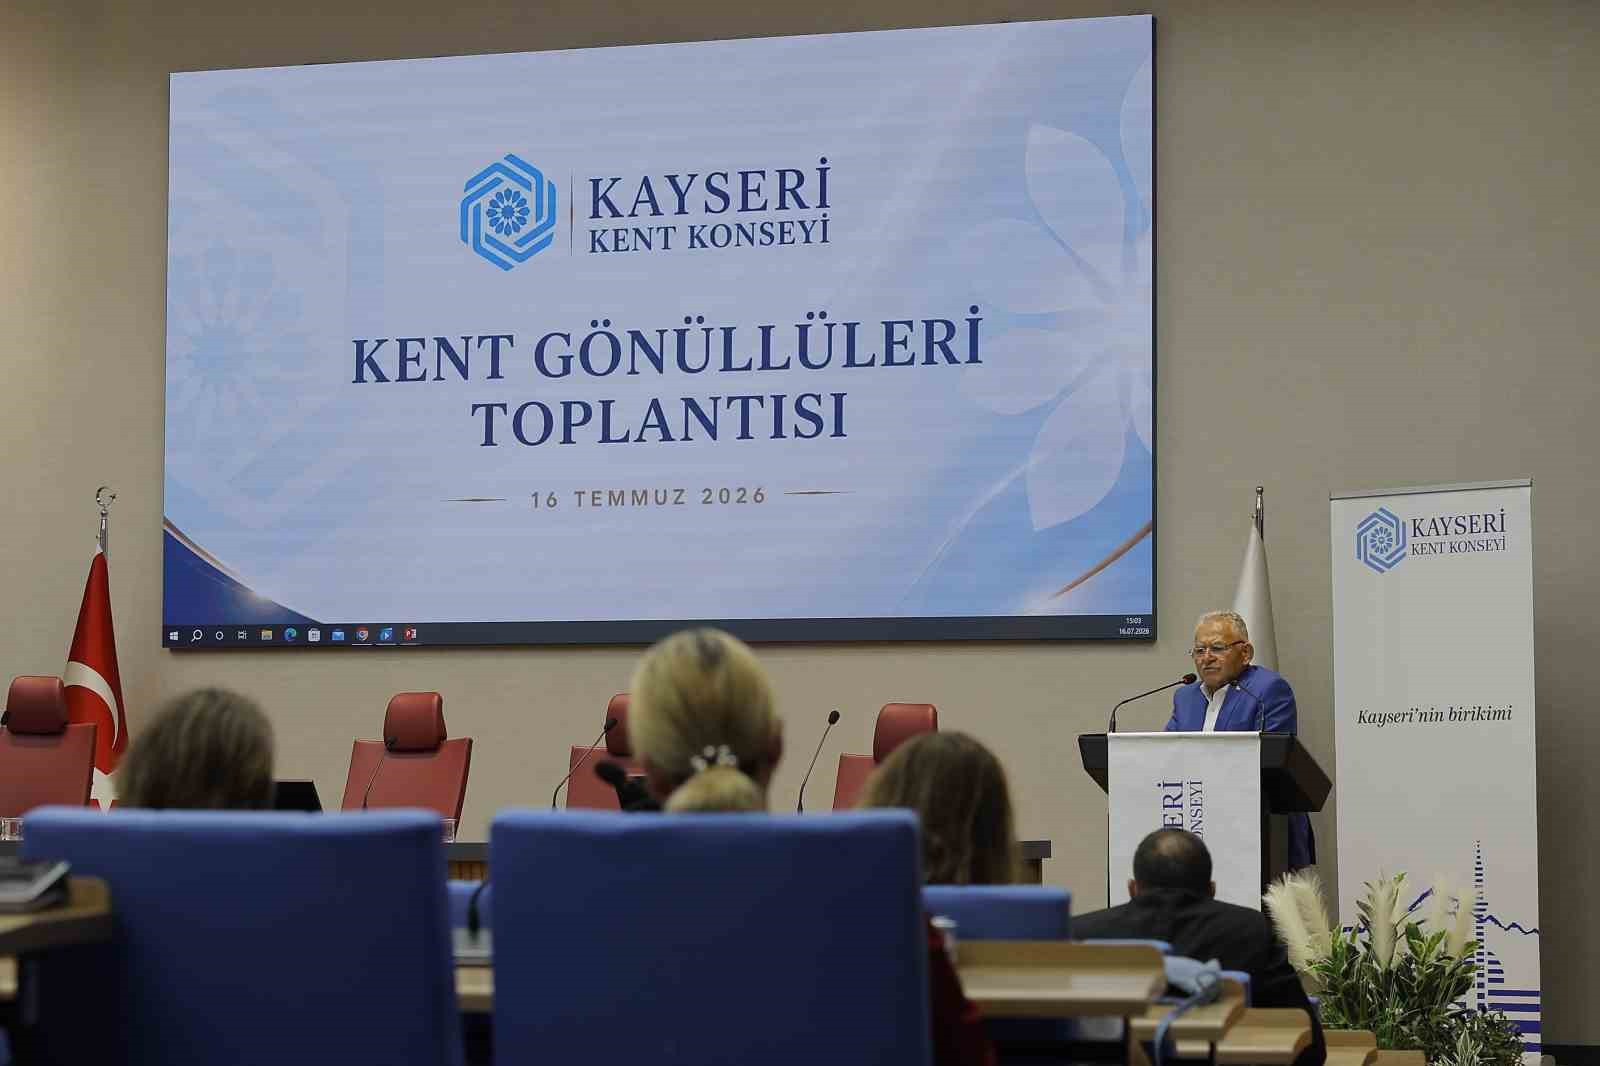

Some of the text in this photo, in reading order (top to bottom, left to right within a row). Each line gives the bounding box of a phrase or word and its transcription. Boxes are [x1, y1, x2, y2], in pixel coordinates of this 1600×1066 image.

[588, 157, 831, 219] KAYSERİ
[588, 212, 831, 254] KENT KONSEYİ
[351, 305, 984, 384] KENT GÖNÜLLÜLERİ
[471, 392, 848, 447] TOPLANTISI
[531, 487, 766, 509] 16 TEMMUZ 2026
[1411, 508, 1506, 538] KAYSERİ
[1411, 535, 1506, 556] KENT KONSEYİ
[1358, 705, 1513, 728] Kayseri’nin birikimi
[1187, 780, 1204, 840] NSEYİ
